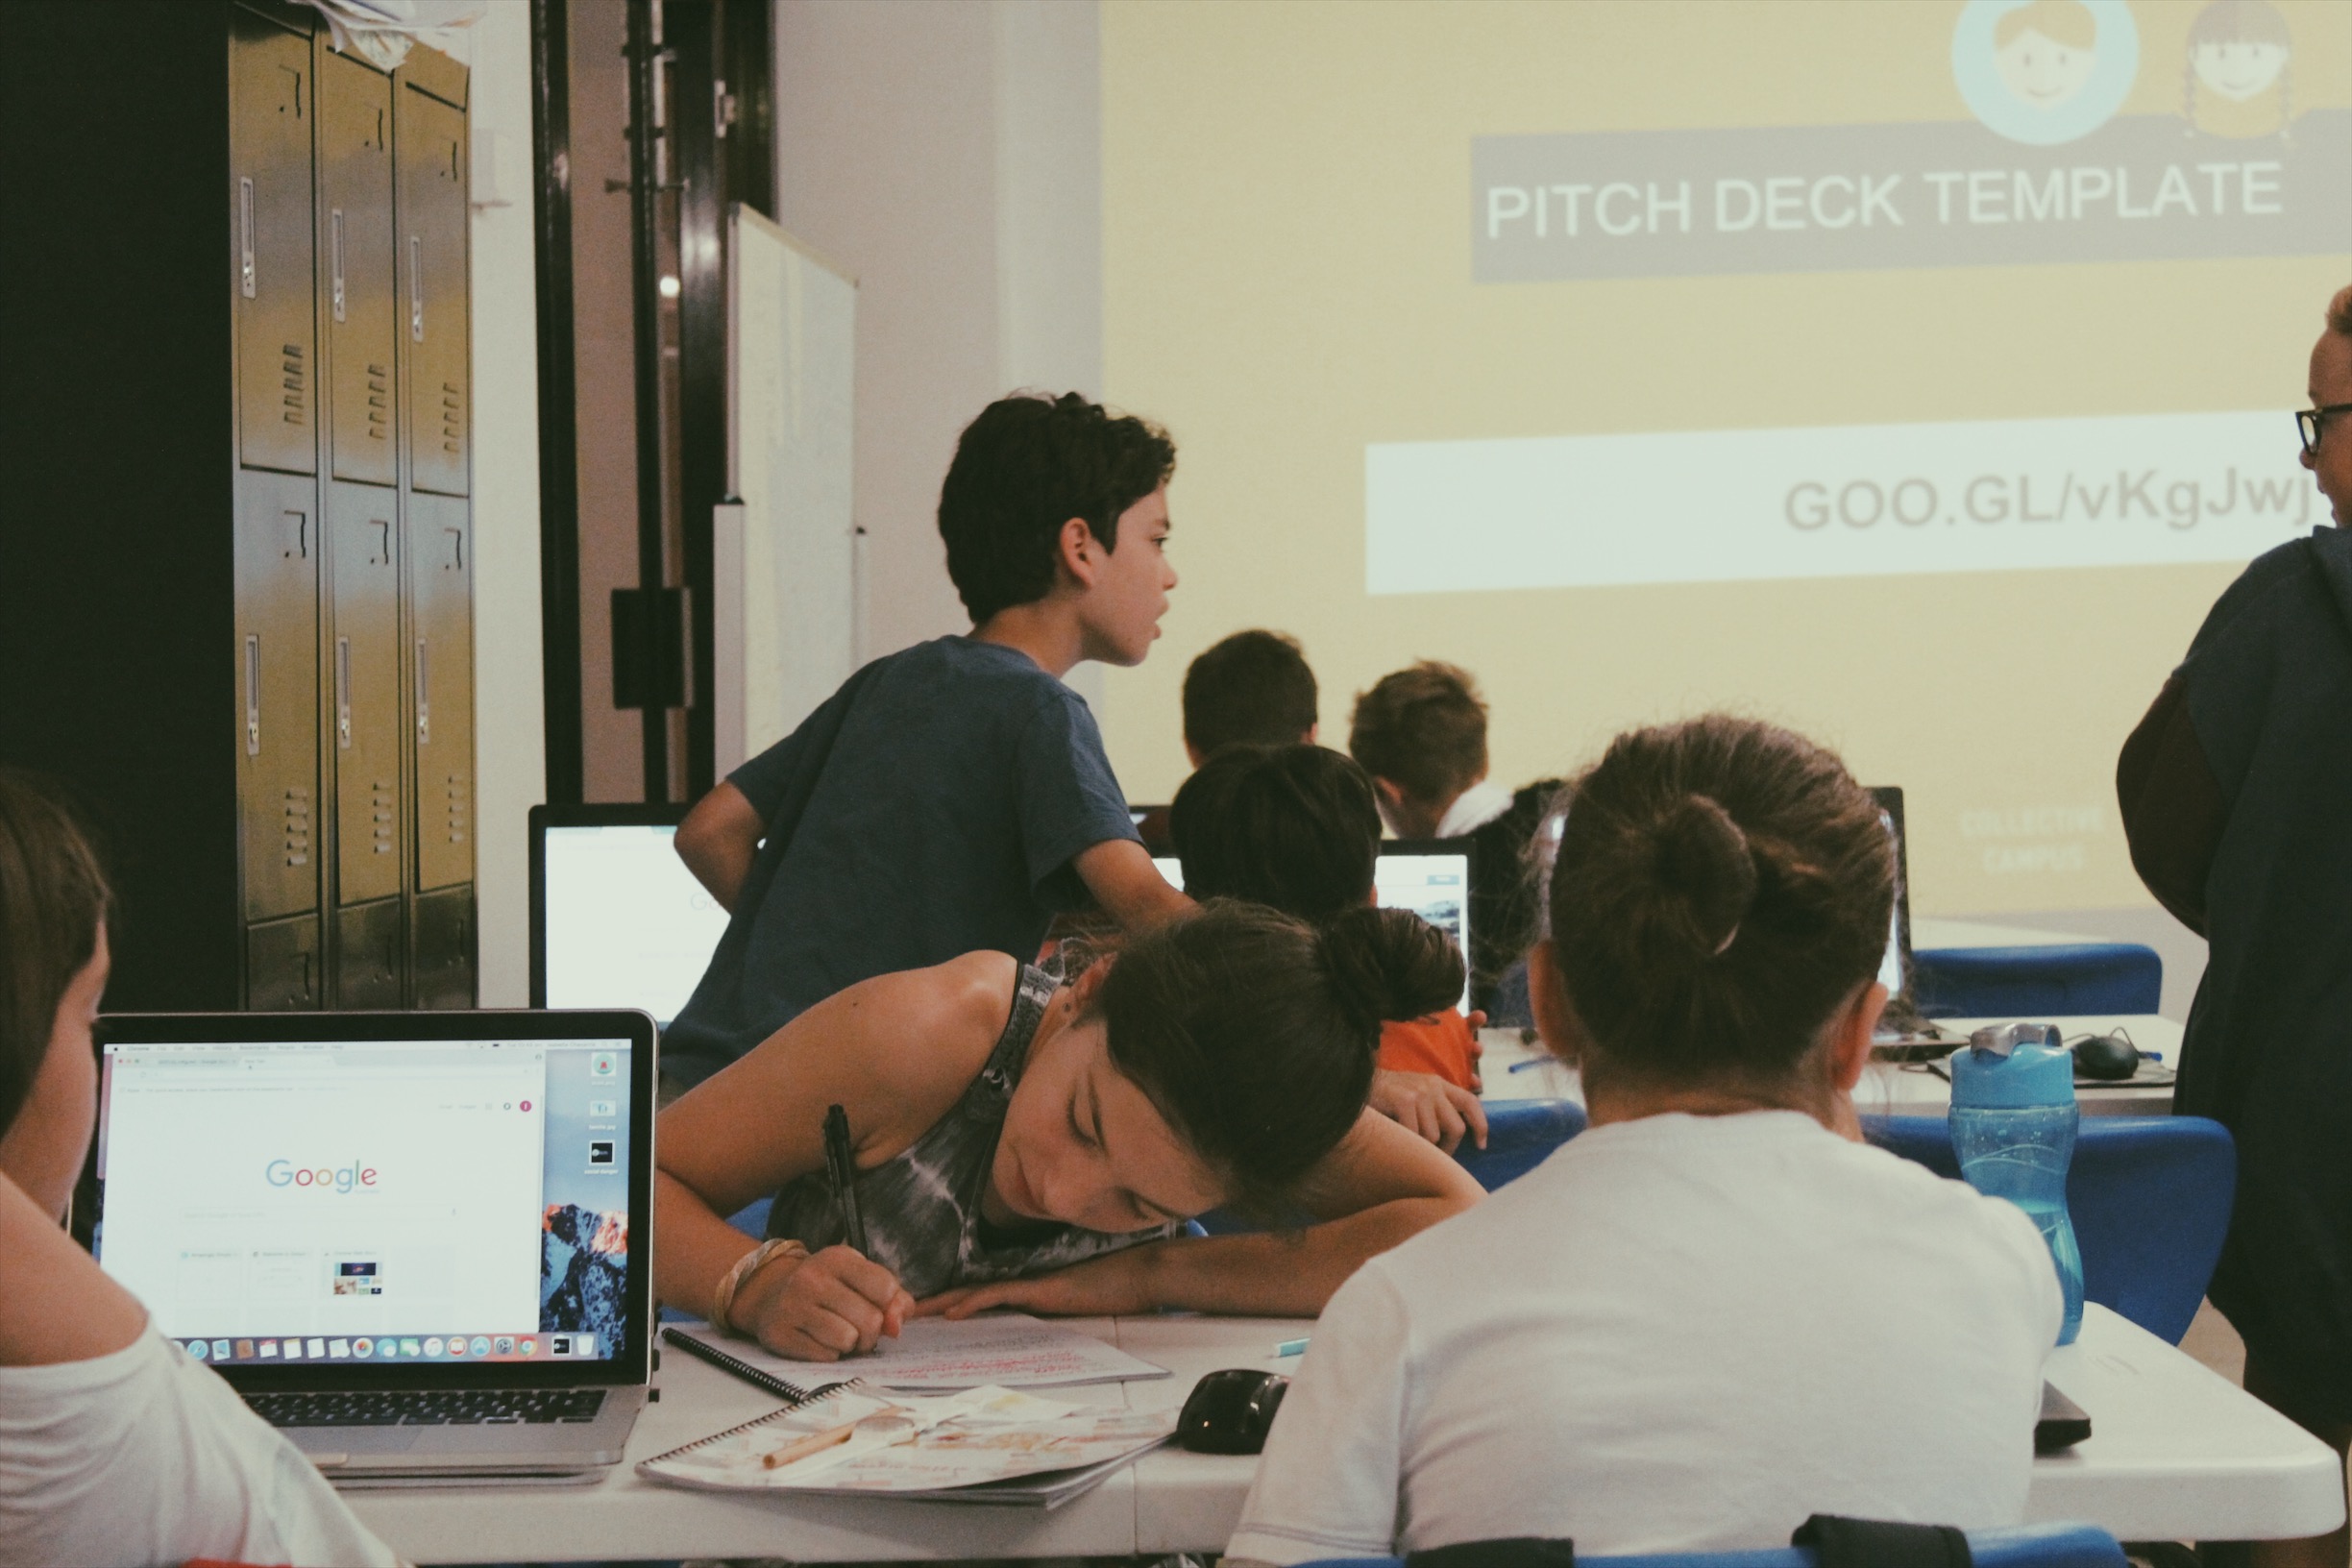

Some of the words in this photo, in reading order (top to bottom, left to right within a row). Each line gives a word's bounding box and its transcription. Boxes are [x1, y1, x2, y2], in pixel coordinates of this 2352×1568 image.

[1487, 181, 1690, 238] PITCH
[1715, 174, 1905, 232] DECK
[1923, 160, 2284, 224] TEMPLATE
[1784, 466, 2311, 531] GOO.GL/vKgJwj
[265, 1159, 378, 1194] Google
